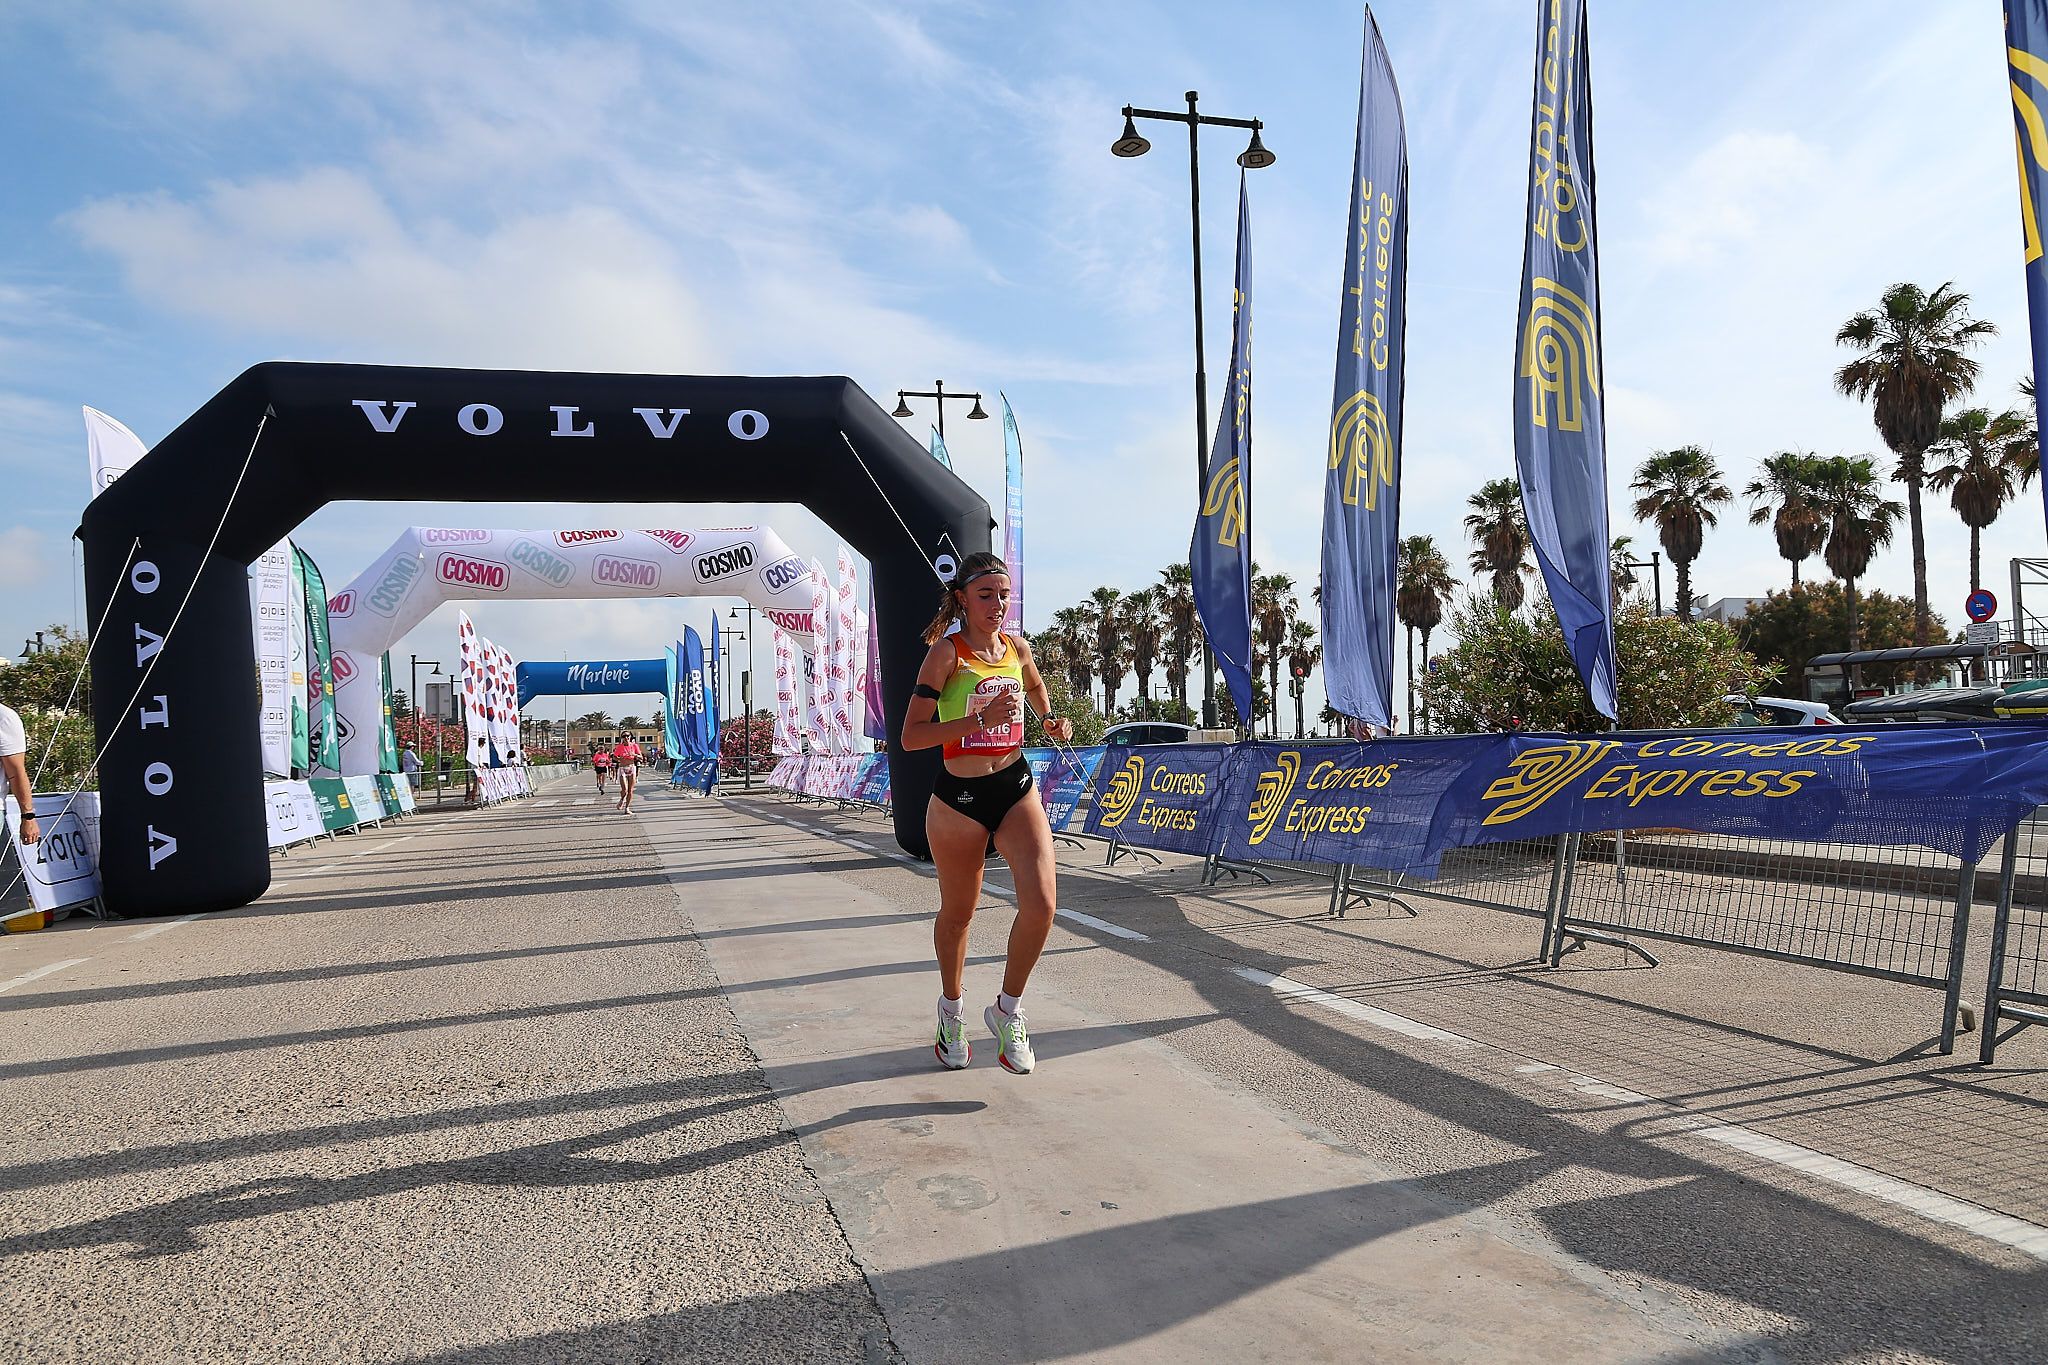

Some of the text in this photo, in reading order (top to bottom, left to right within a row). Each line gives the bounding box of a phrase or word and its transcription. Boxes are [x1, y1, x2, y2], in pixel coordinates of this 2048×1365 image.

[352, 399, 770, 441] VOLVO
[426, 529, 487, 543] COSMO
[442, 557, 504, 588] COSMO
[512, 541, 570, 584] COSMO
[598, 559, 656, 586] COSMO
[698, 546, 753, 579] COSMO
[370, 556, 420, 612] COSMO
[567, 663, 630, 690] Marlene
[981, 682, 1019, 694] Serrano
[131, 560, 178, 871] VOLVO
[1636, 736, 1878, 759] Correos
[1149, 764, 1206, 797] Correos
[1306, 760, 1399, 791] Correos
[1584, 764, 1819, 808] Express
[1138, 798, 1198, 834] Express
[1284, 798, 1372, 842] Express
